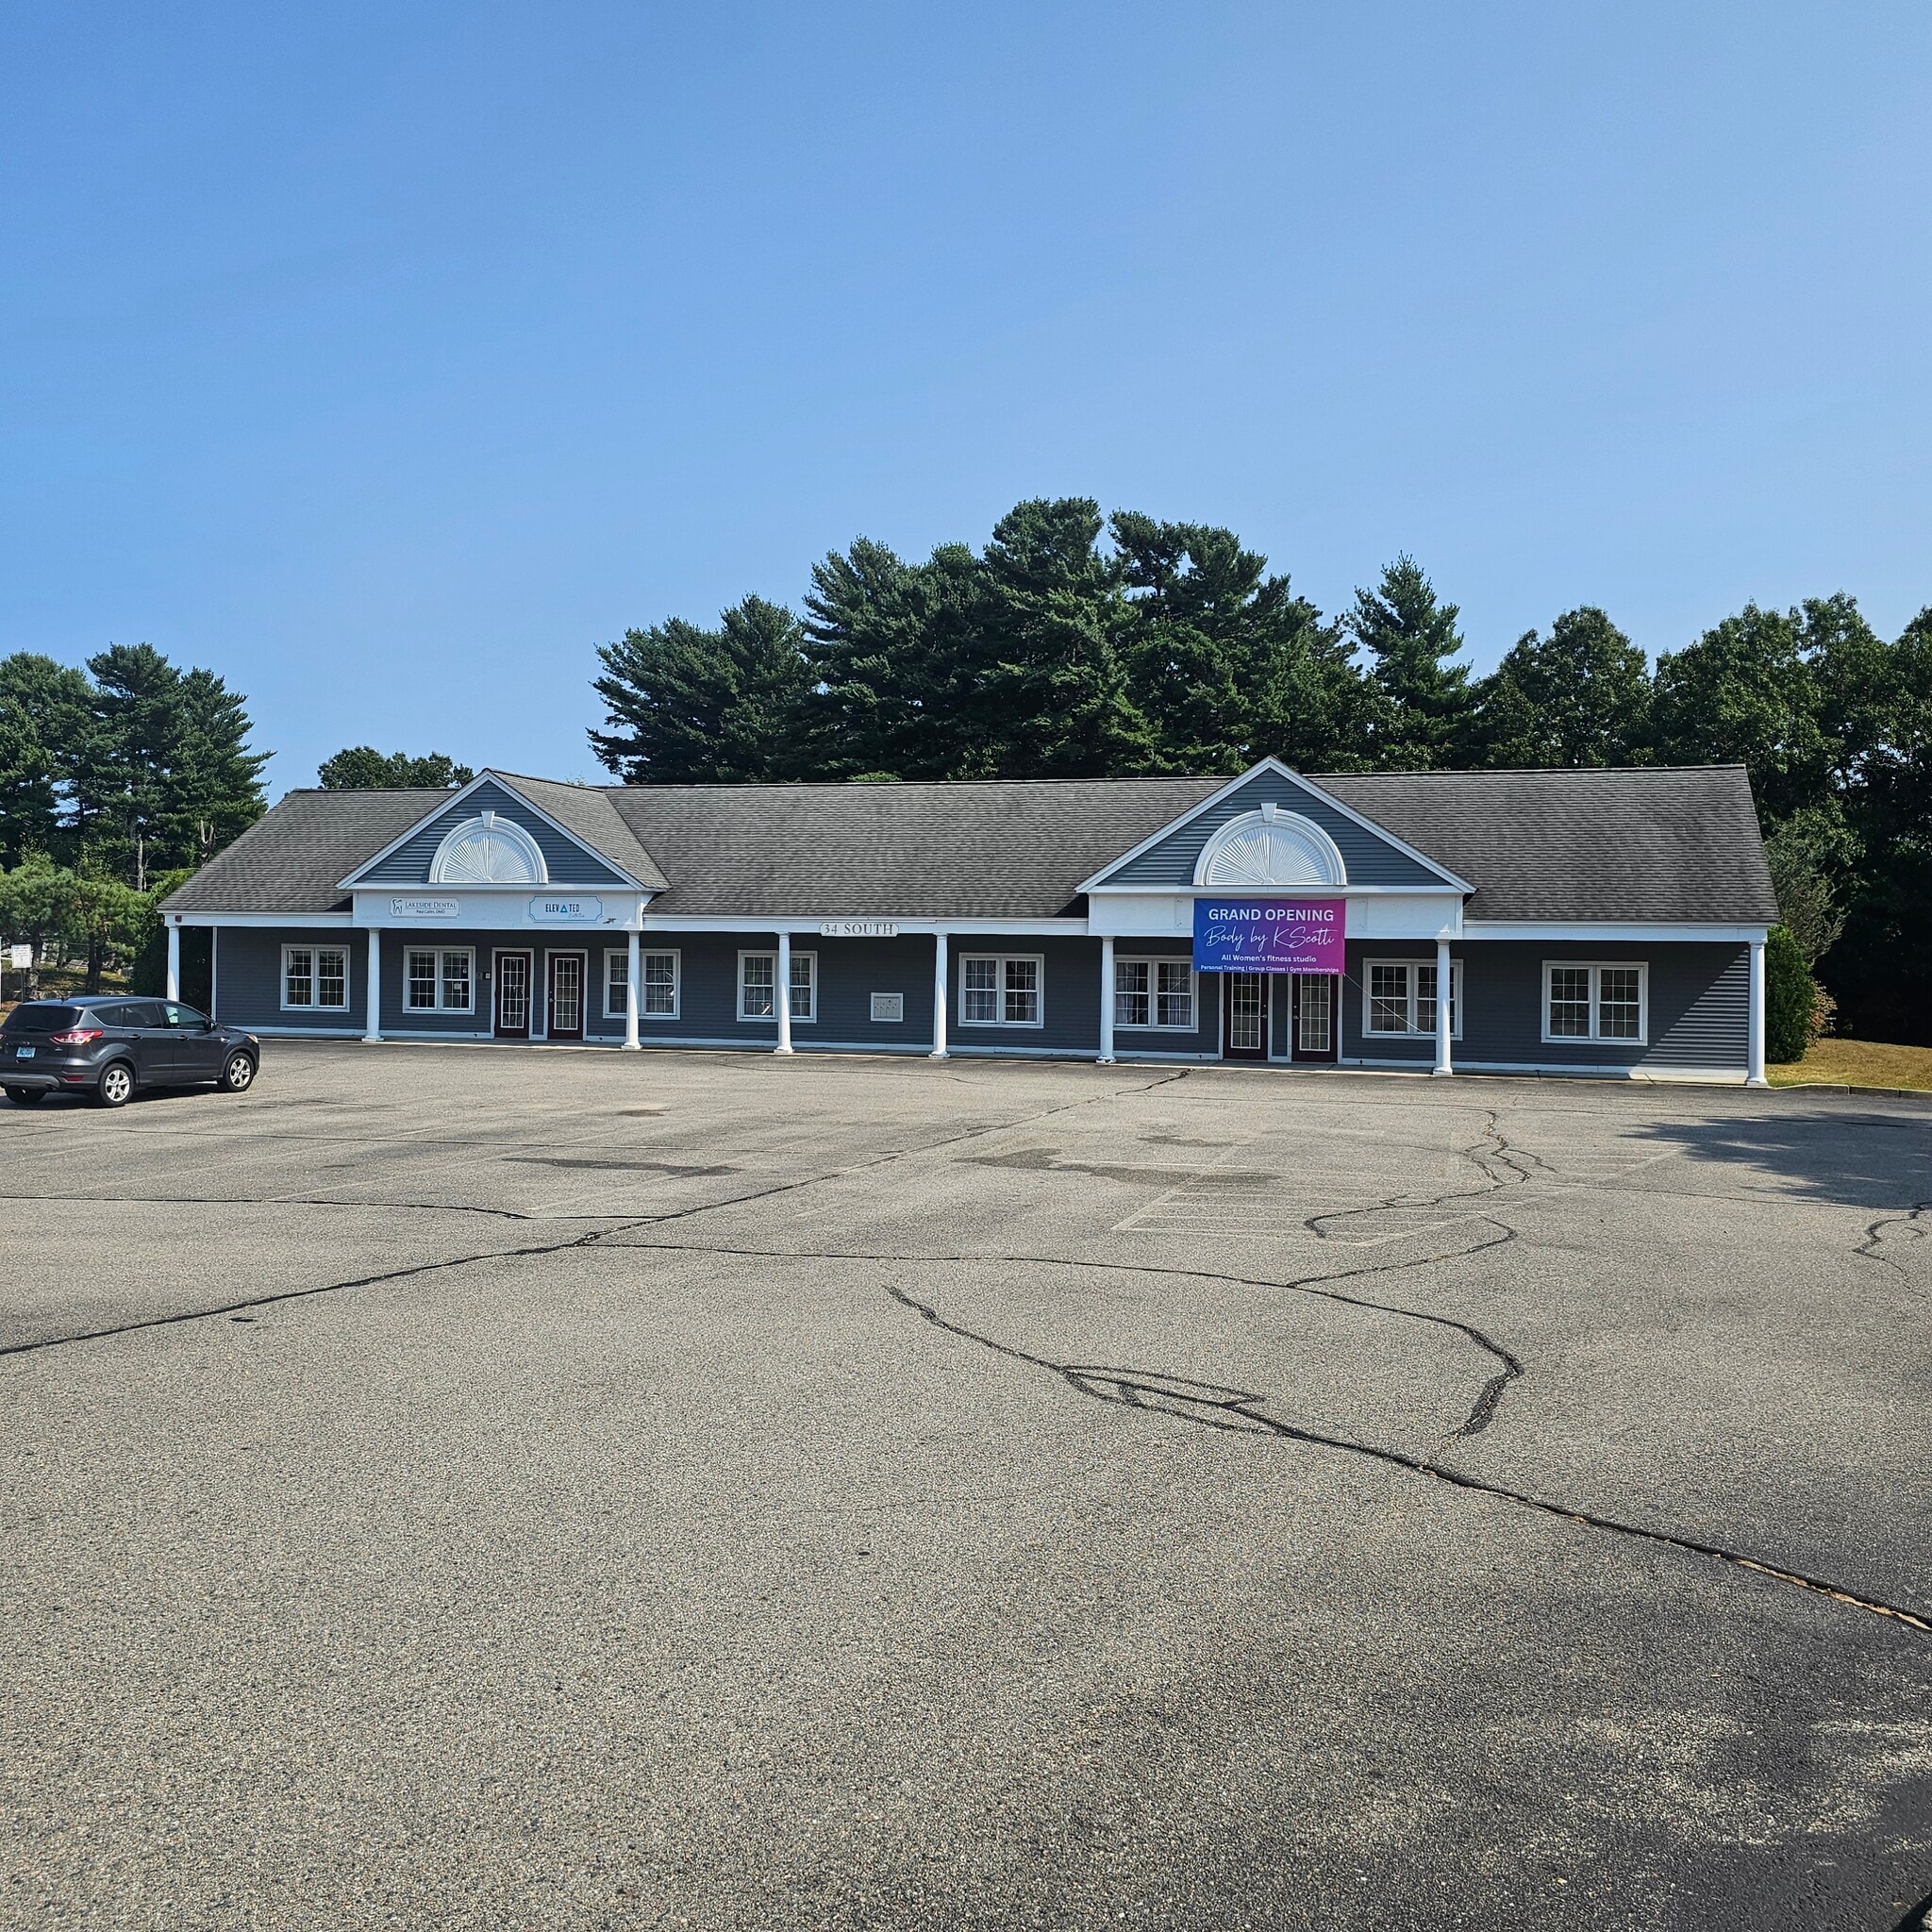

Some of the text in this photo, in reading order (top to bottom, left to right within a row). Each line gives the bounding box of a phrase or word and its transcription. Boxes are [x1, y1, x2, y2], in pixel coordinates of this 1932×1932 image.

[1208, 908, 1334, 922] GRAND OPENING
[825, 923, 893, 934] 34 SOUTH
[1204, 925, 1245, 951] Body
[1250, 926, 1268, 951] by
